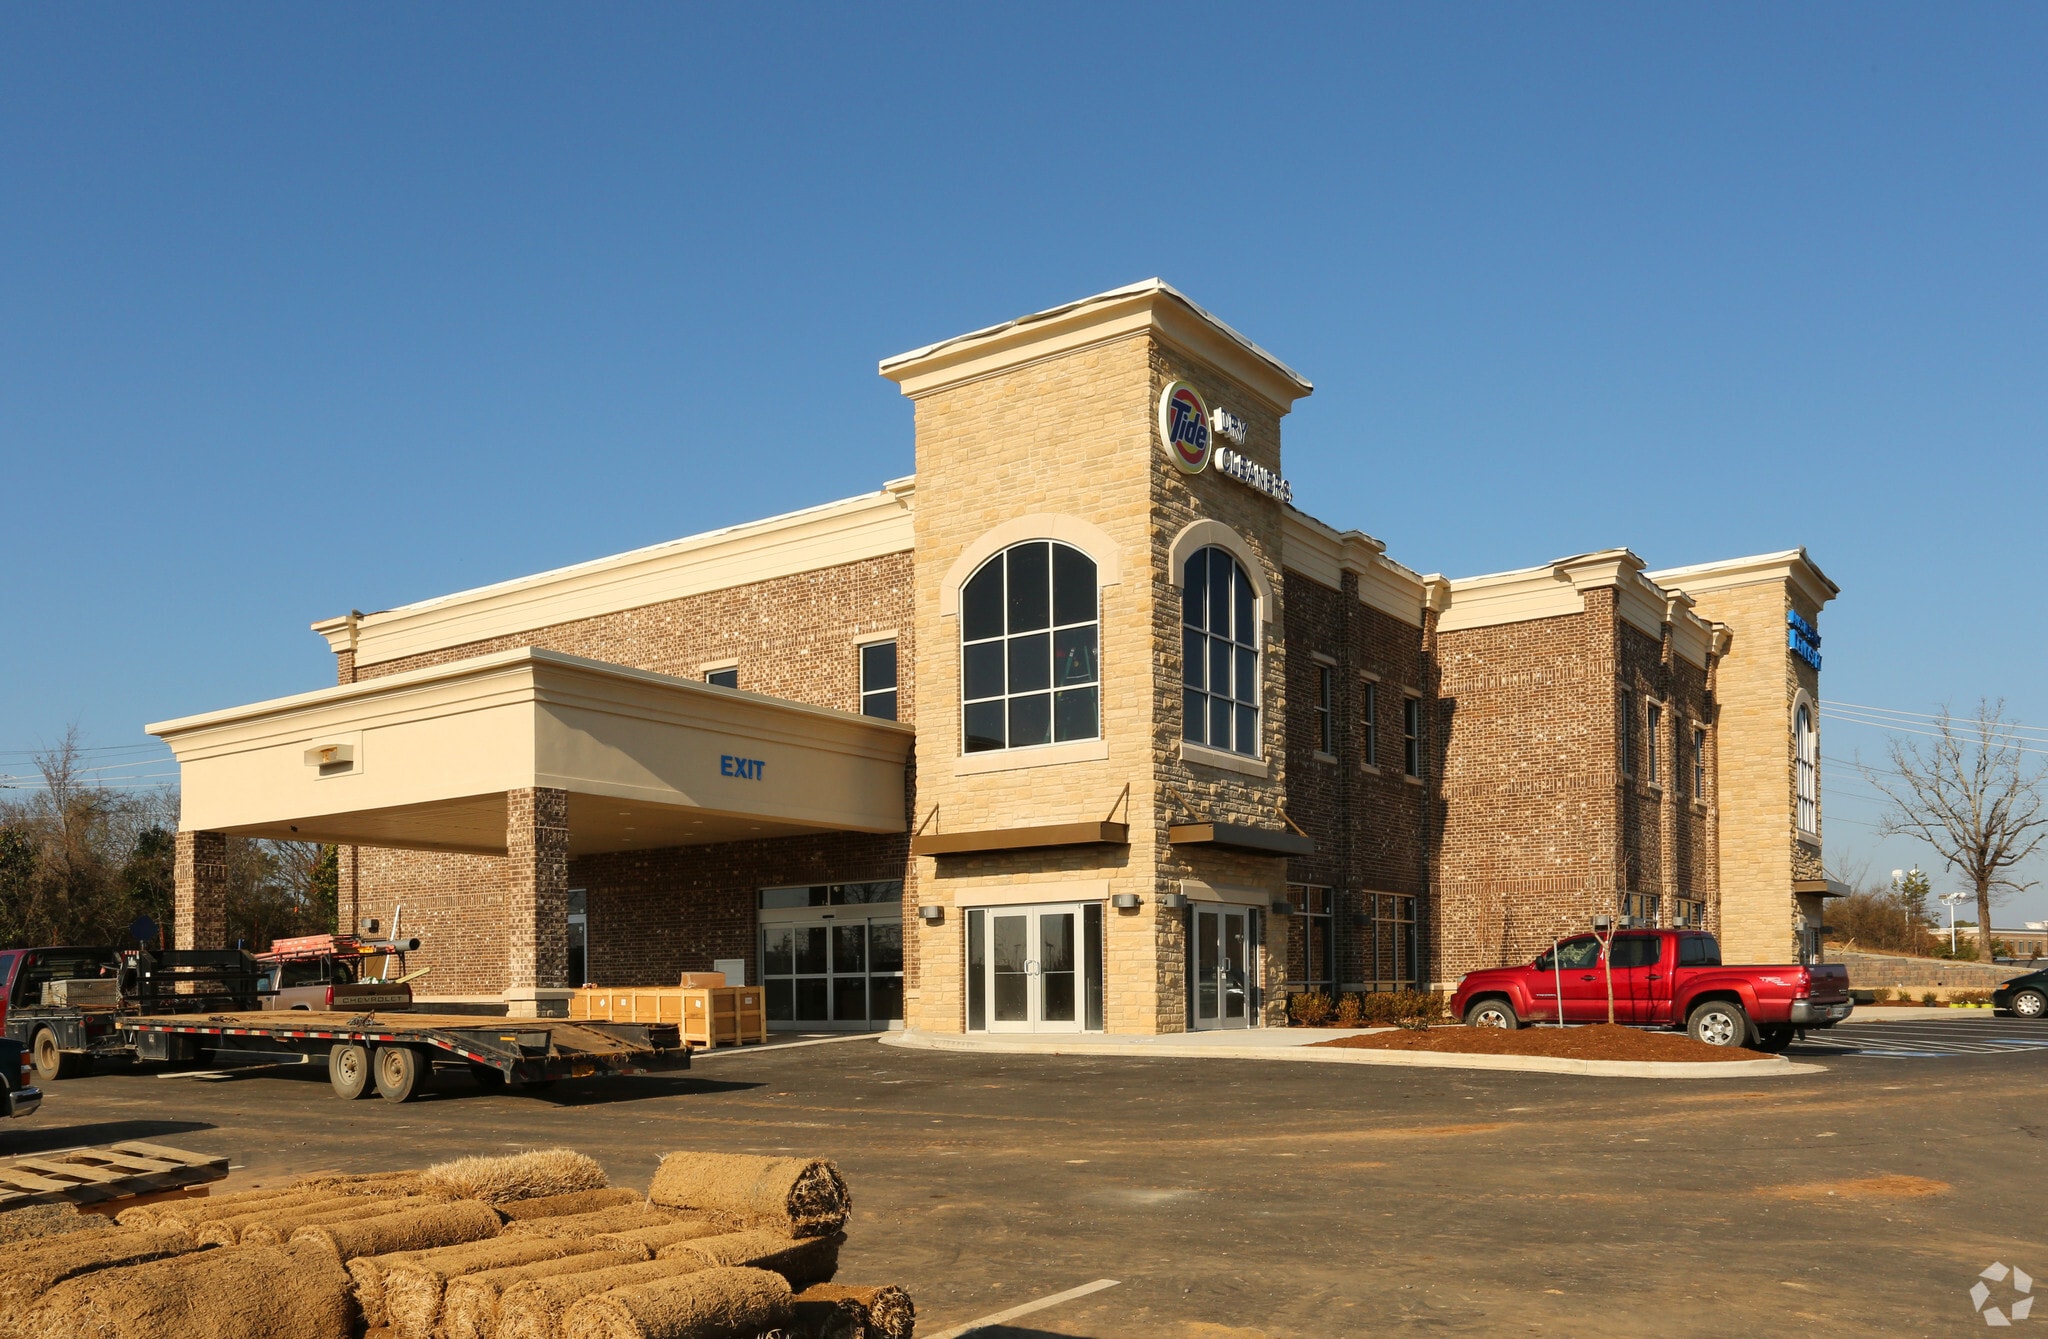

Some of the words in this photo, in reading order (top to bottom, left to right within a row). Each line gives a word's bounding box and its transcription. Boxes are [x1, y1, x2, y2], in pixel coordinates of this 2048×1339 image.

[1170, 398, 1208, 450] Tide
[1214, 406, 1248, 445] DRY
[1215, 447, 1292, 503] CLEANERS
[720, 754, 766, 782] EXIT
[342, 996, 403, 1004] CHEVROLET
